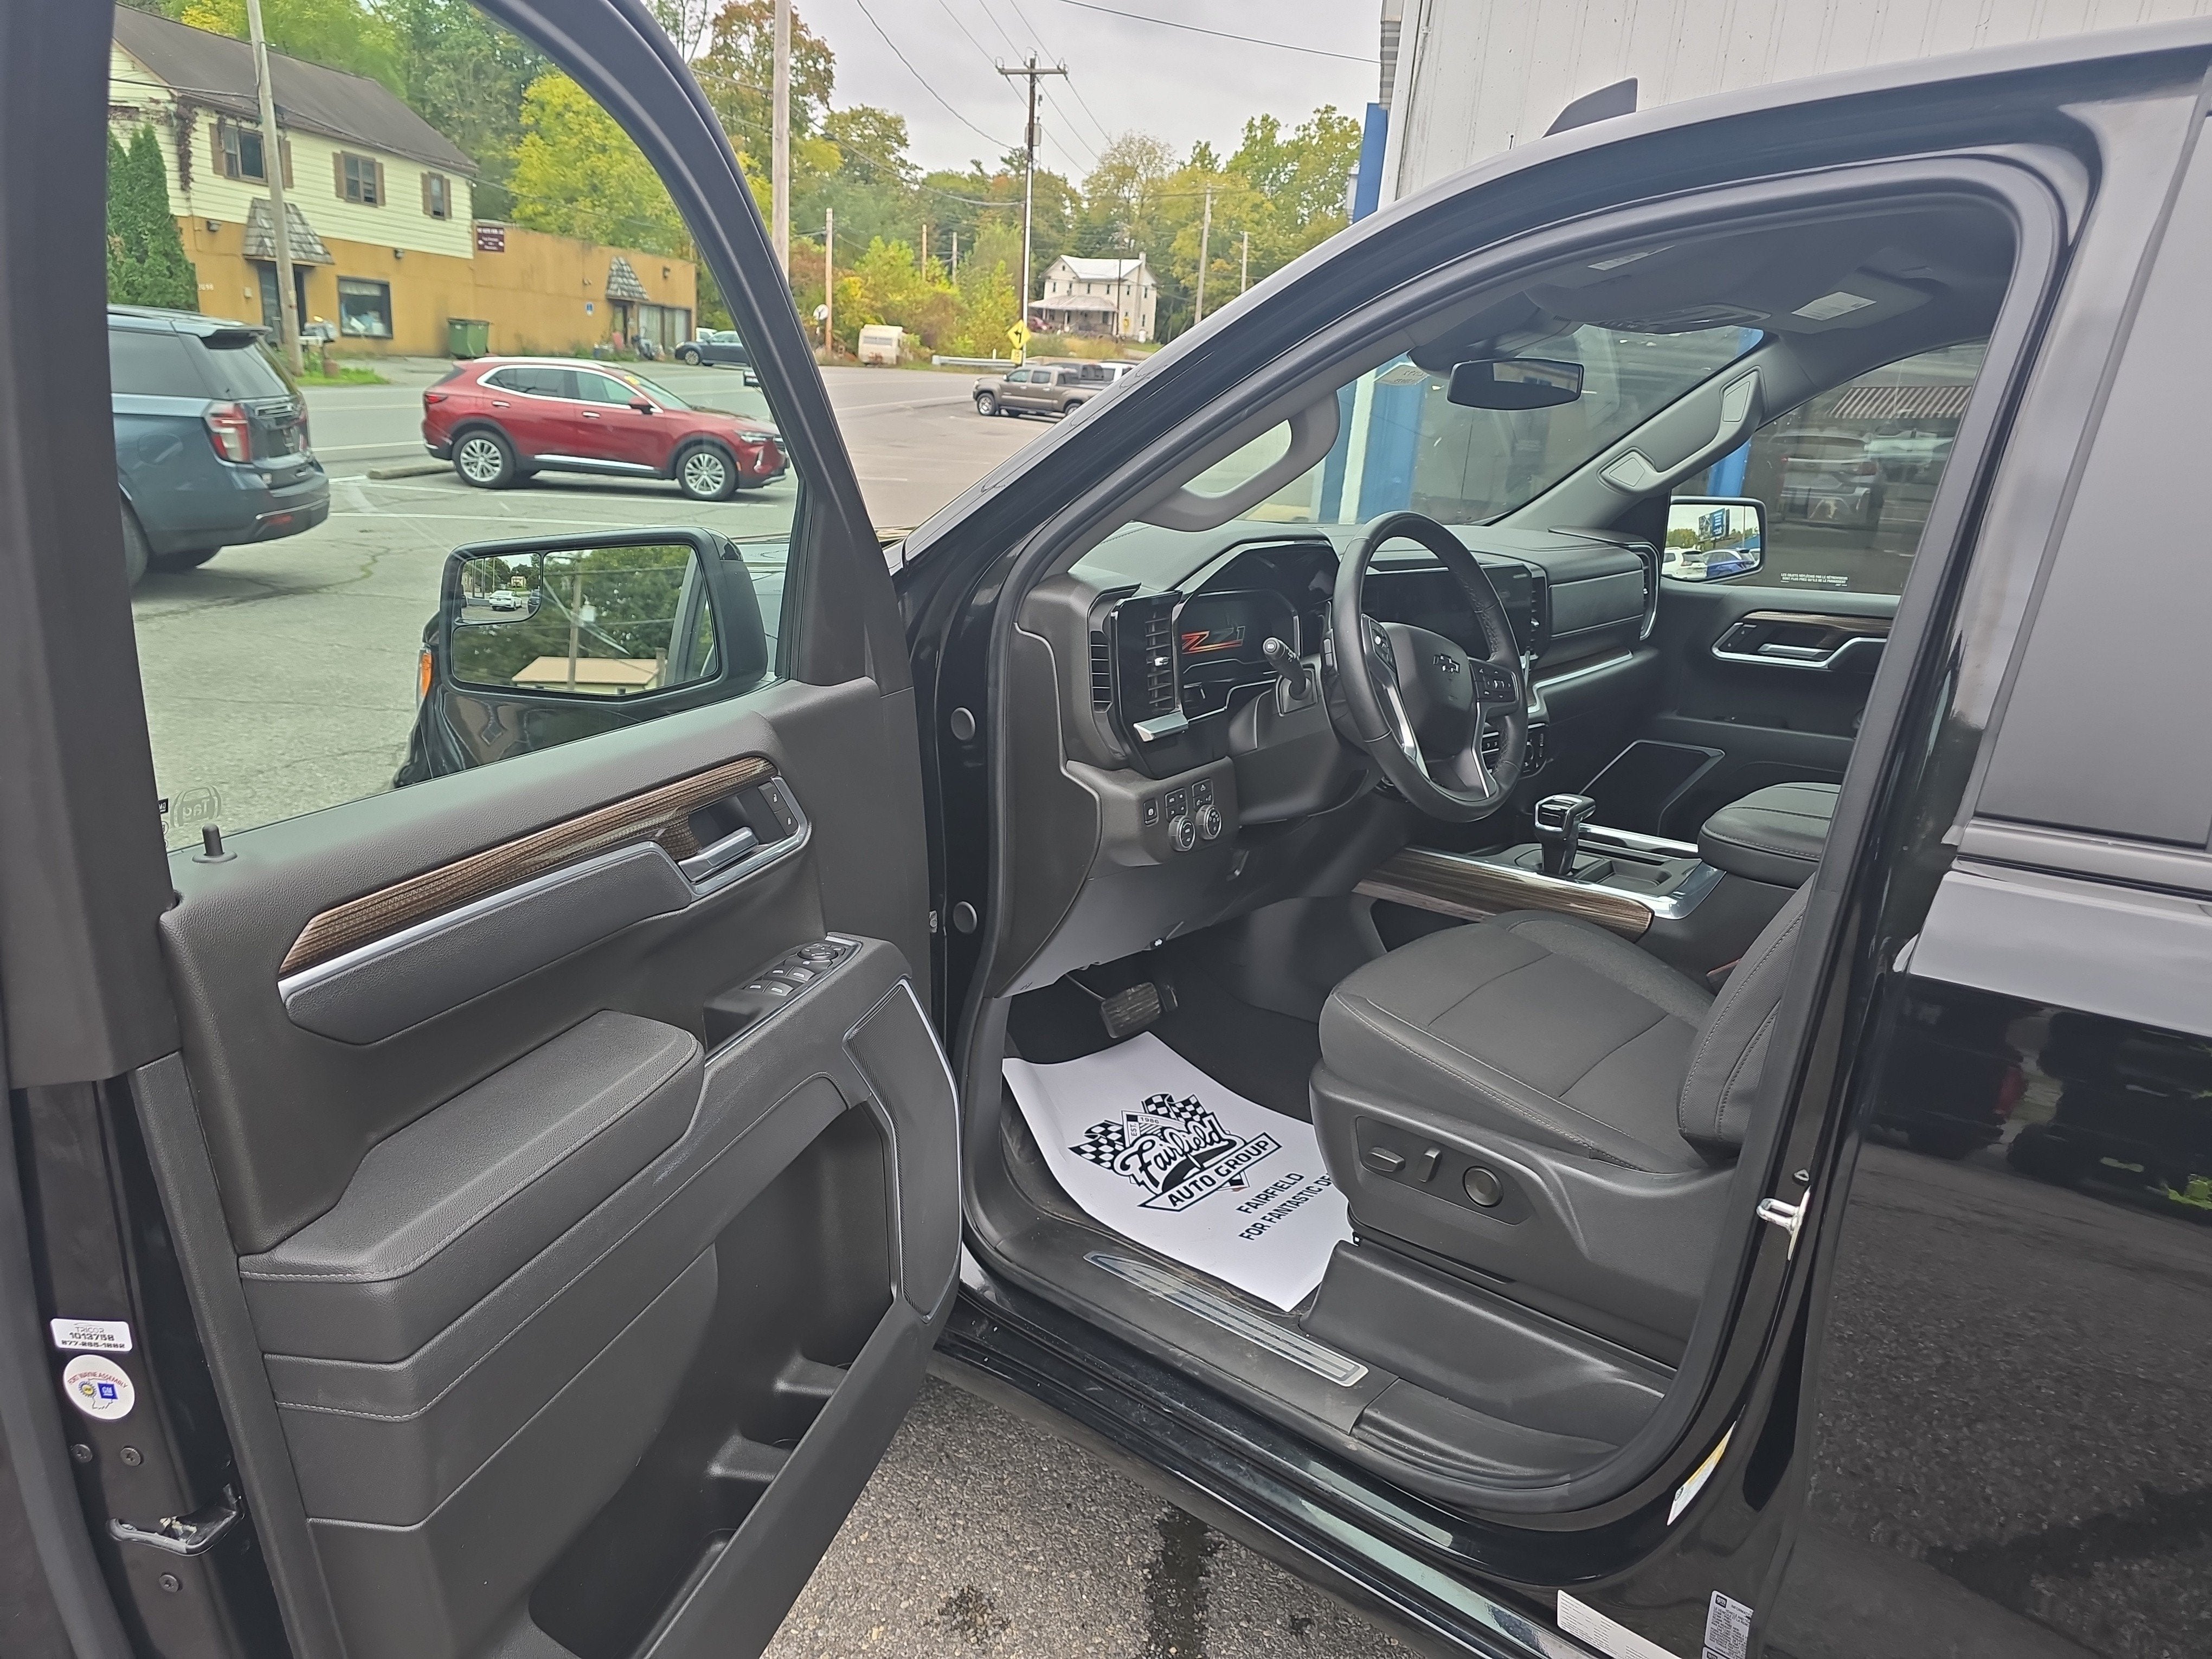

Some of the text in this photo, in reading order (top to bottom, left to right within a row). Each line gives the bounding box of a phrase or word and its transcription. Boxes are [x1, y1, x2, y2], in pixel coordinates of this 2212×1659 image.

[1120, 1118, 1237, 1188] Fairfield
[1167, 1140, 1269, 1207] AUTO GROUP
[1236, 1173, 1305, 1214] FAIRFIELD
[1238, 1222, 1271, 1240] FOR
[1260, 1186, 1323, 1224] FANTASTIC
[1716, 1596, 1726, 1605] gm
